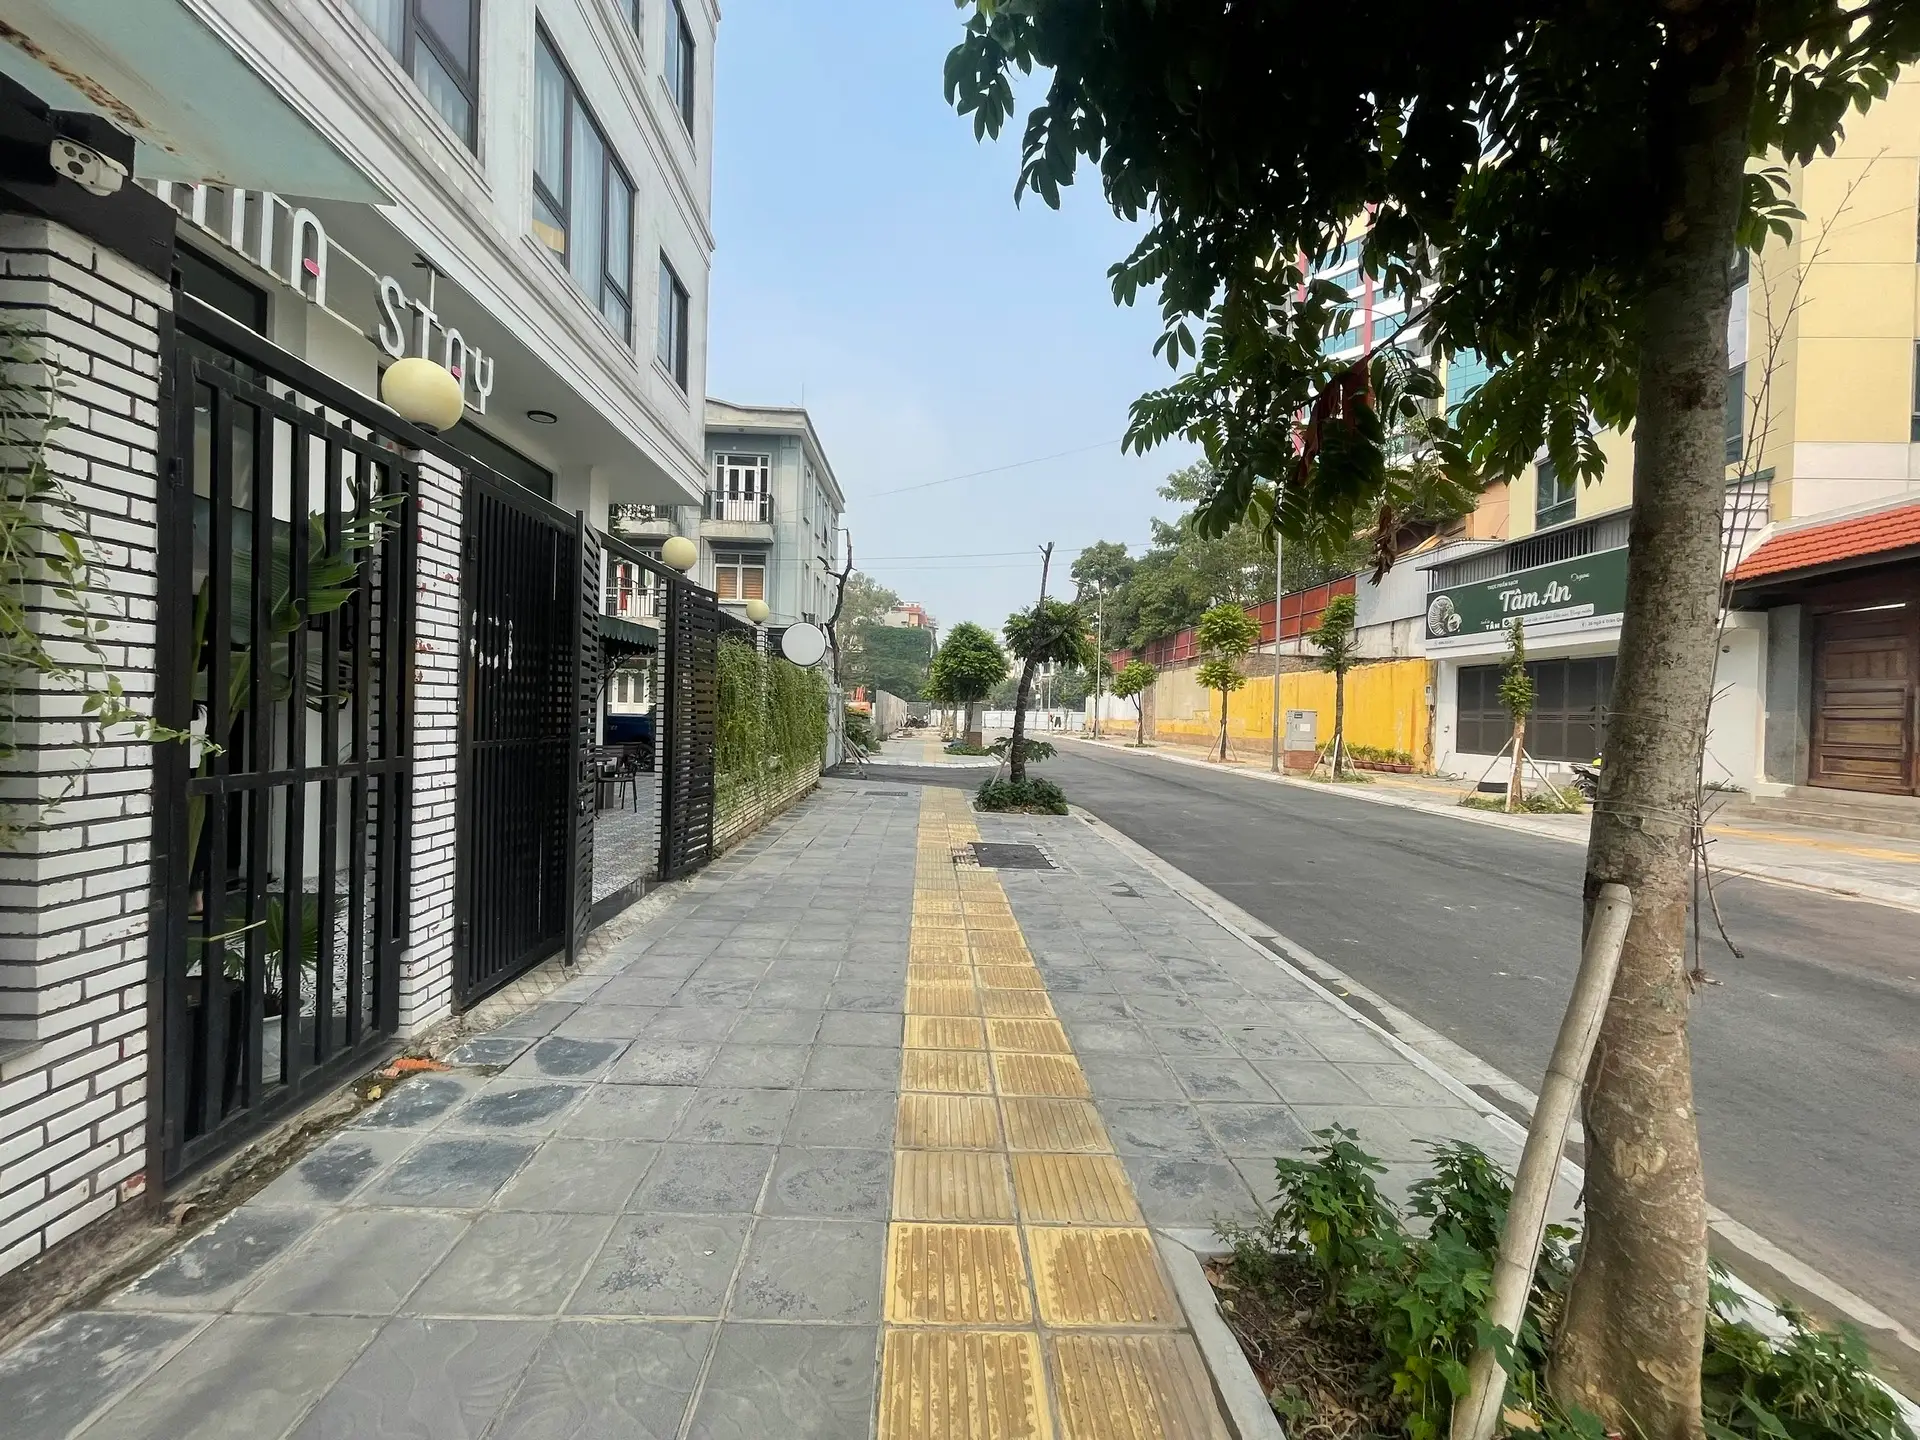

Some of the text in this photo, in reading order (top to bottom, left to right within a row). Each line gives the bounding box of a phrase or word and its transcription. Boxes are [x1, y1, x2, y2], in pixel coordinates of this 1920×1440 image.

[378, 275, 494, 415] STAY
[1499, 580, 1572, 612] Tâm An
